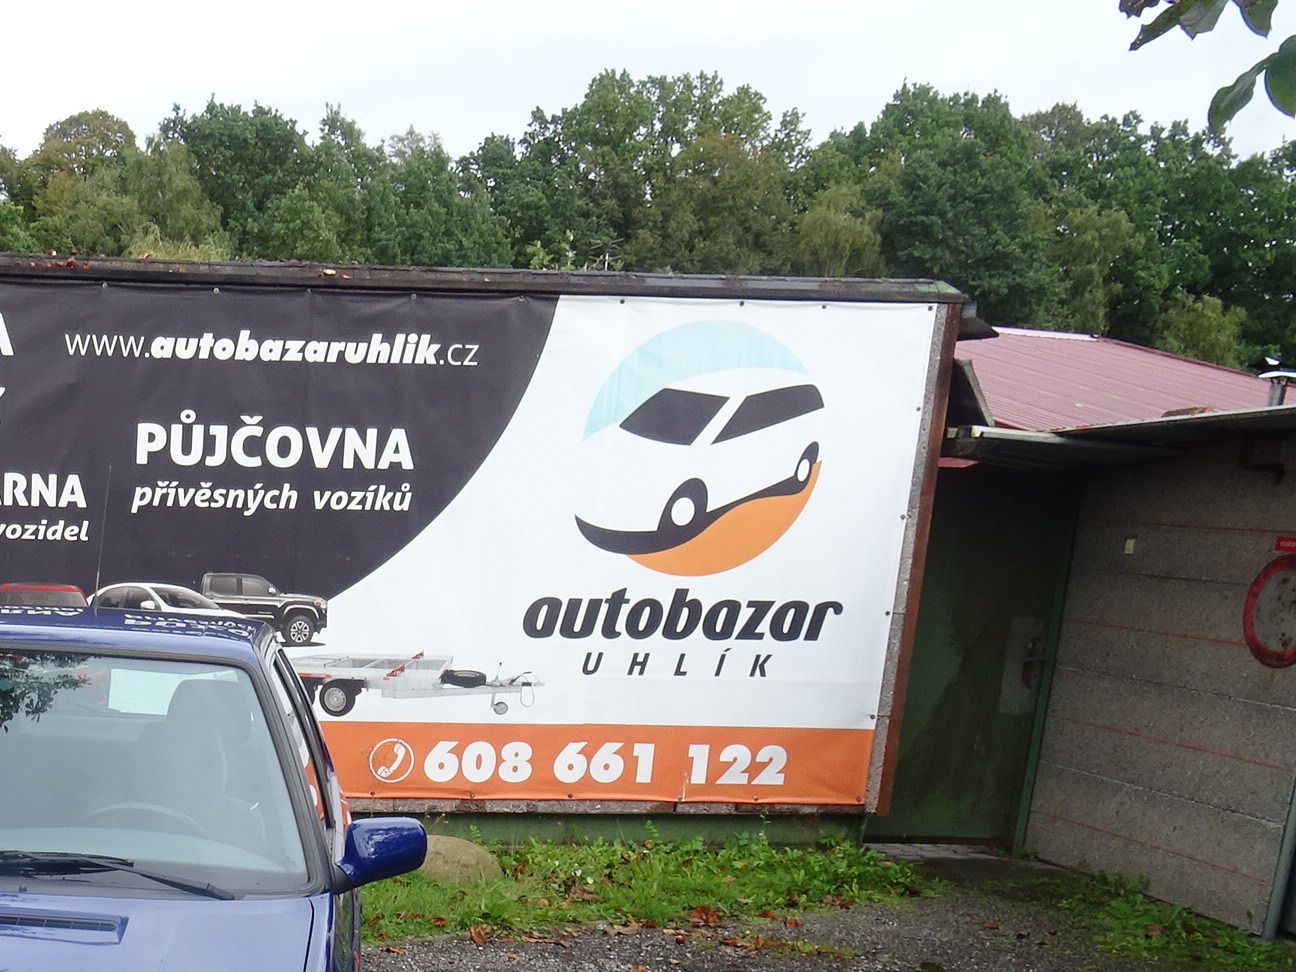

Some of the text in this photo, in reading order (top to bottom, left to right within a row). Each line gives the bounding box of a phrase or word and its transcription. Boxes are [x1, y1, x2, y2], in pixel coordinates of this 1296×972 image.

[64, 329, 481, 367] www.autobazaruhlik.cz
[135, 409, 415, 471] PŮJČOVNA
[130, 480, 413, 516] přívěsných vozíků
[522, 586, 844, 642] autobazar
[422, 740, 789, 786] 608 661 122
